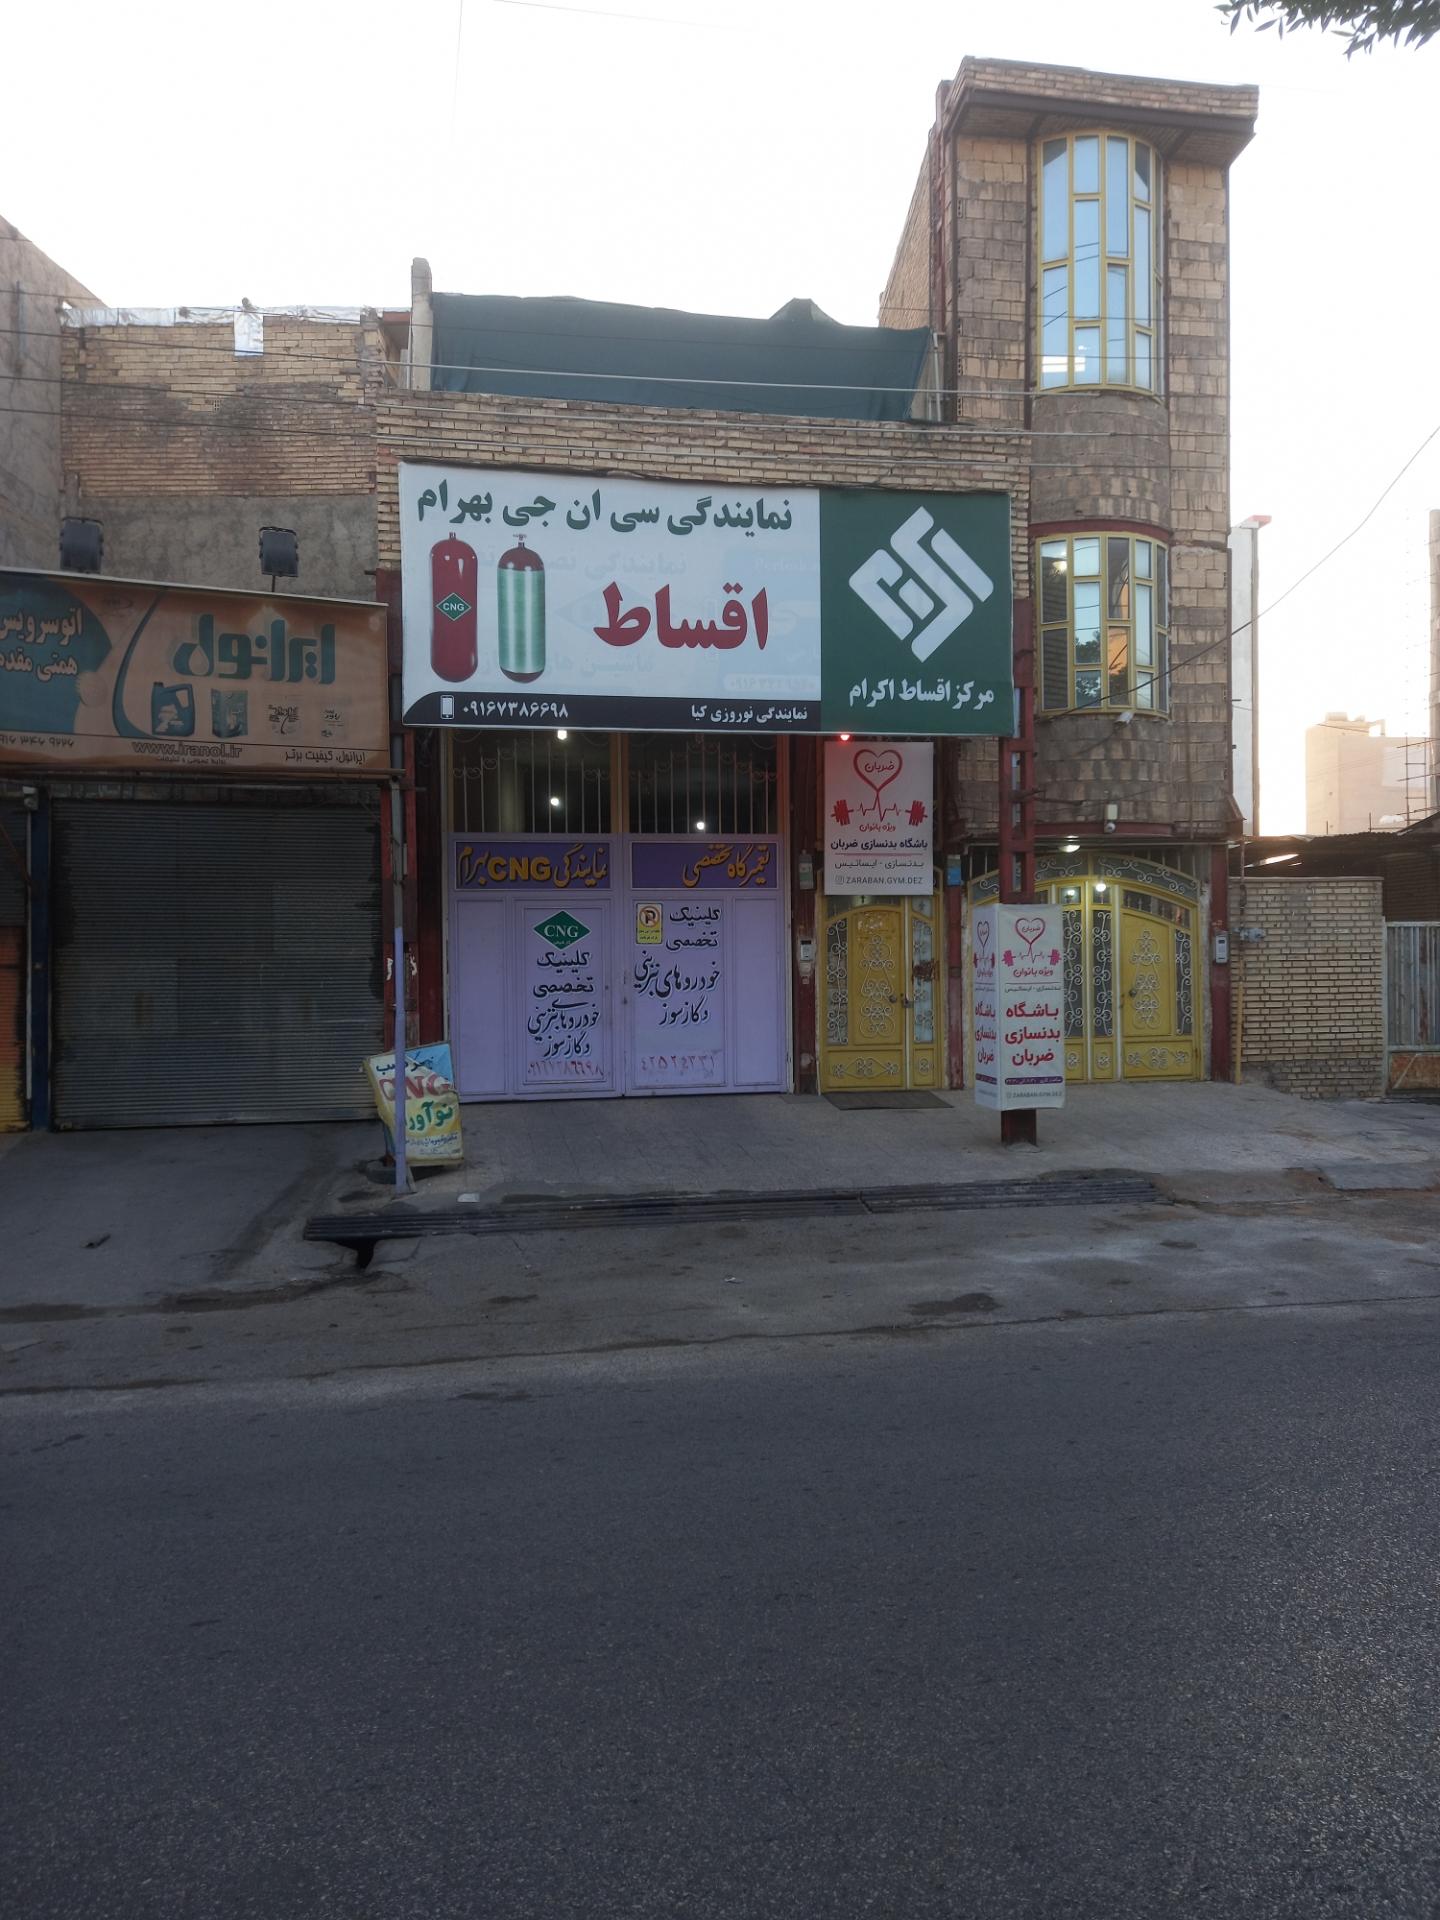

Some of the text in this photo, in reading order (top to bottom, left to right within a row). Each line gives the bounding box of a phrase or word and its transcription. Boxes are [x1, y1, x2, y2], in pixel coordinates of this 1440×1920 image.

[417, 479, 792, 537] نمایندگی سی ان جی بهرام
[442, 601, 465, 612] CNG
[593, 581, 769, 650] اقساط
[173, 614, 336, 684] ایرانول
[36, 653, 78, 681] همتی
[849, 677, 894, 708] اکرام
[899, 678, 950, 703] اقساط
[953, 680, 994, 710] مرکز
[462, 703, 569, 719] ۰۹۱۶۷۳۸۶۶۹۸
[691, 703, 808, 723] نمایندگی نوروزی کیا
[133, 740, 242, 759] www.iranol.ir
[285, 748, 302, 762] برتر
[305, 750, 332, 762] کیفیت
[865, 763, 894, 773] ضربان
[859, 822, 896, 833] ویژه بانوان
[831, 839, 928, 851] باشگاه بدنسازی ضربان
[458, 843, 607, 887] نمایندگی CNG بهرام
[884, 859, 924, 869] بدنسازی
[846, 876, 923, 884] ZARABAN.GYM.DEZ
[670, 907, 720, 928] کلینیک
[544, 925, 578, 937] CNG
[666, 931, 719, 950] تخصصی
[537, 949, 589, 973] کلینیک
[655, 962, 720, 997] خودروهای
[1013, 968, 1053, 977] ویژه بانوان
[533, 976, 594, 997] تخصصی
[1006, 1003, 1059, 1021] باشگاه
[1005, 1028, 1060, 1045] بدنسازی
[1012, 1048, 1054, 1067] ضربان
